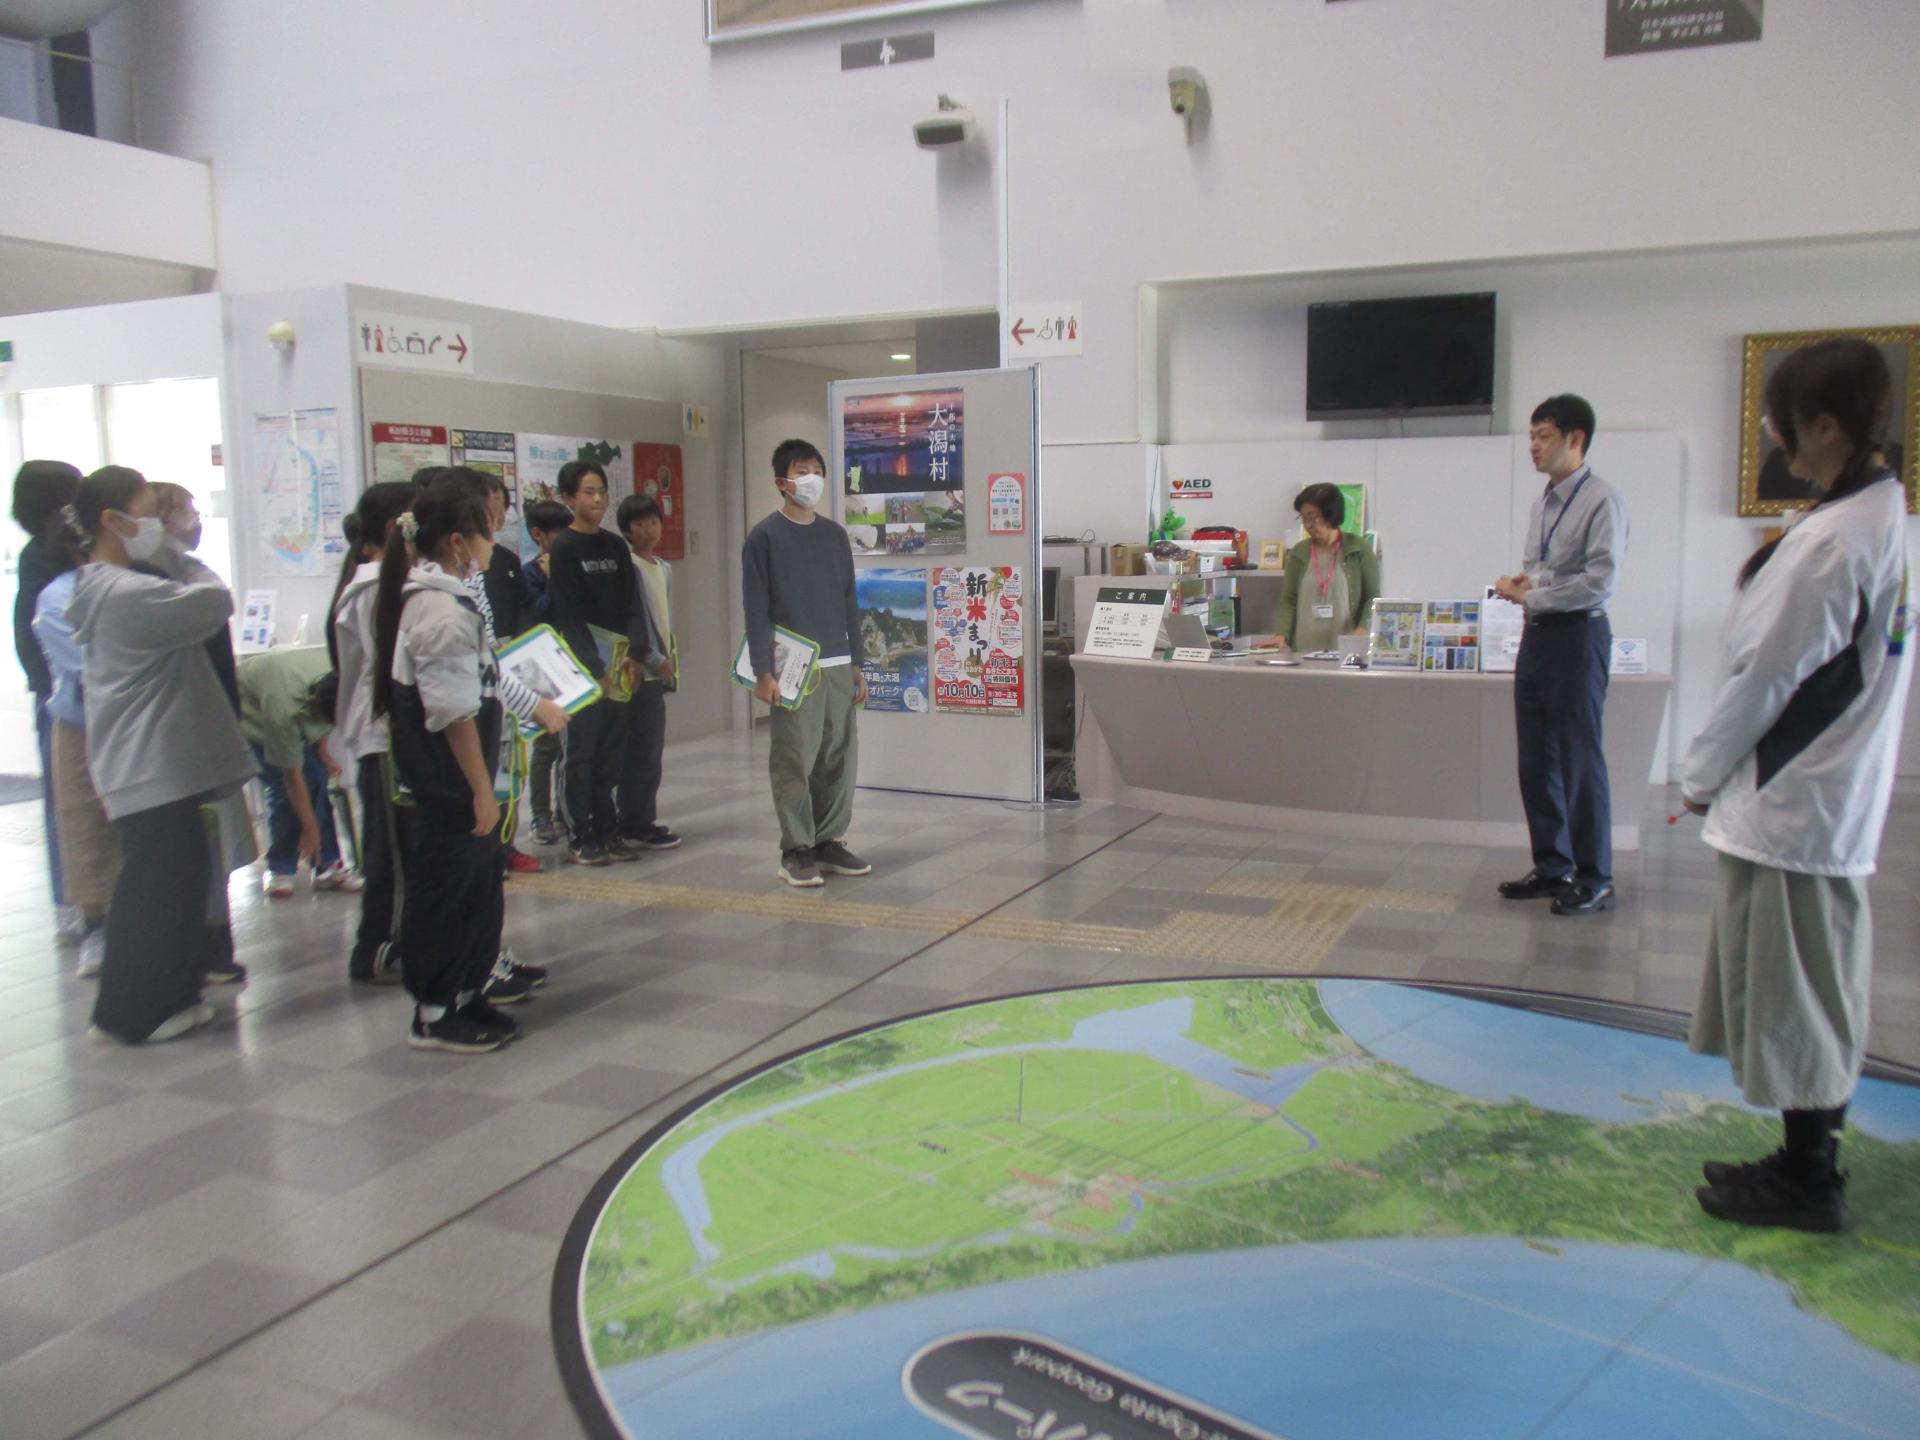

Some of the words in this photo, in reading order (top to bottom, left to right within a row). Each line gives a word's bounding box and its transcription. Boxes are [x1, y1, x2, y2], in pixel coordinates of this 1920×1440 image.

[927, 402, 949, 483] 大潟村
[1183, 479, 1211, 489] AED
[1115, 592, 1147, 601] ご案内
[966, 571, 988, 665] 新米まつり
[944, 683, 985, 698] 10月10日
